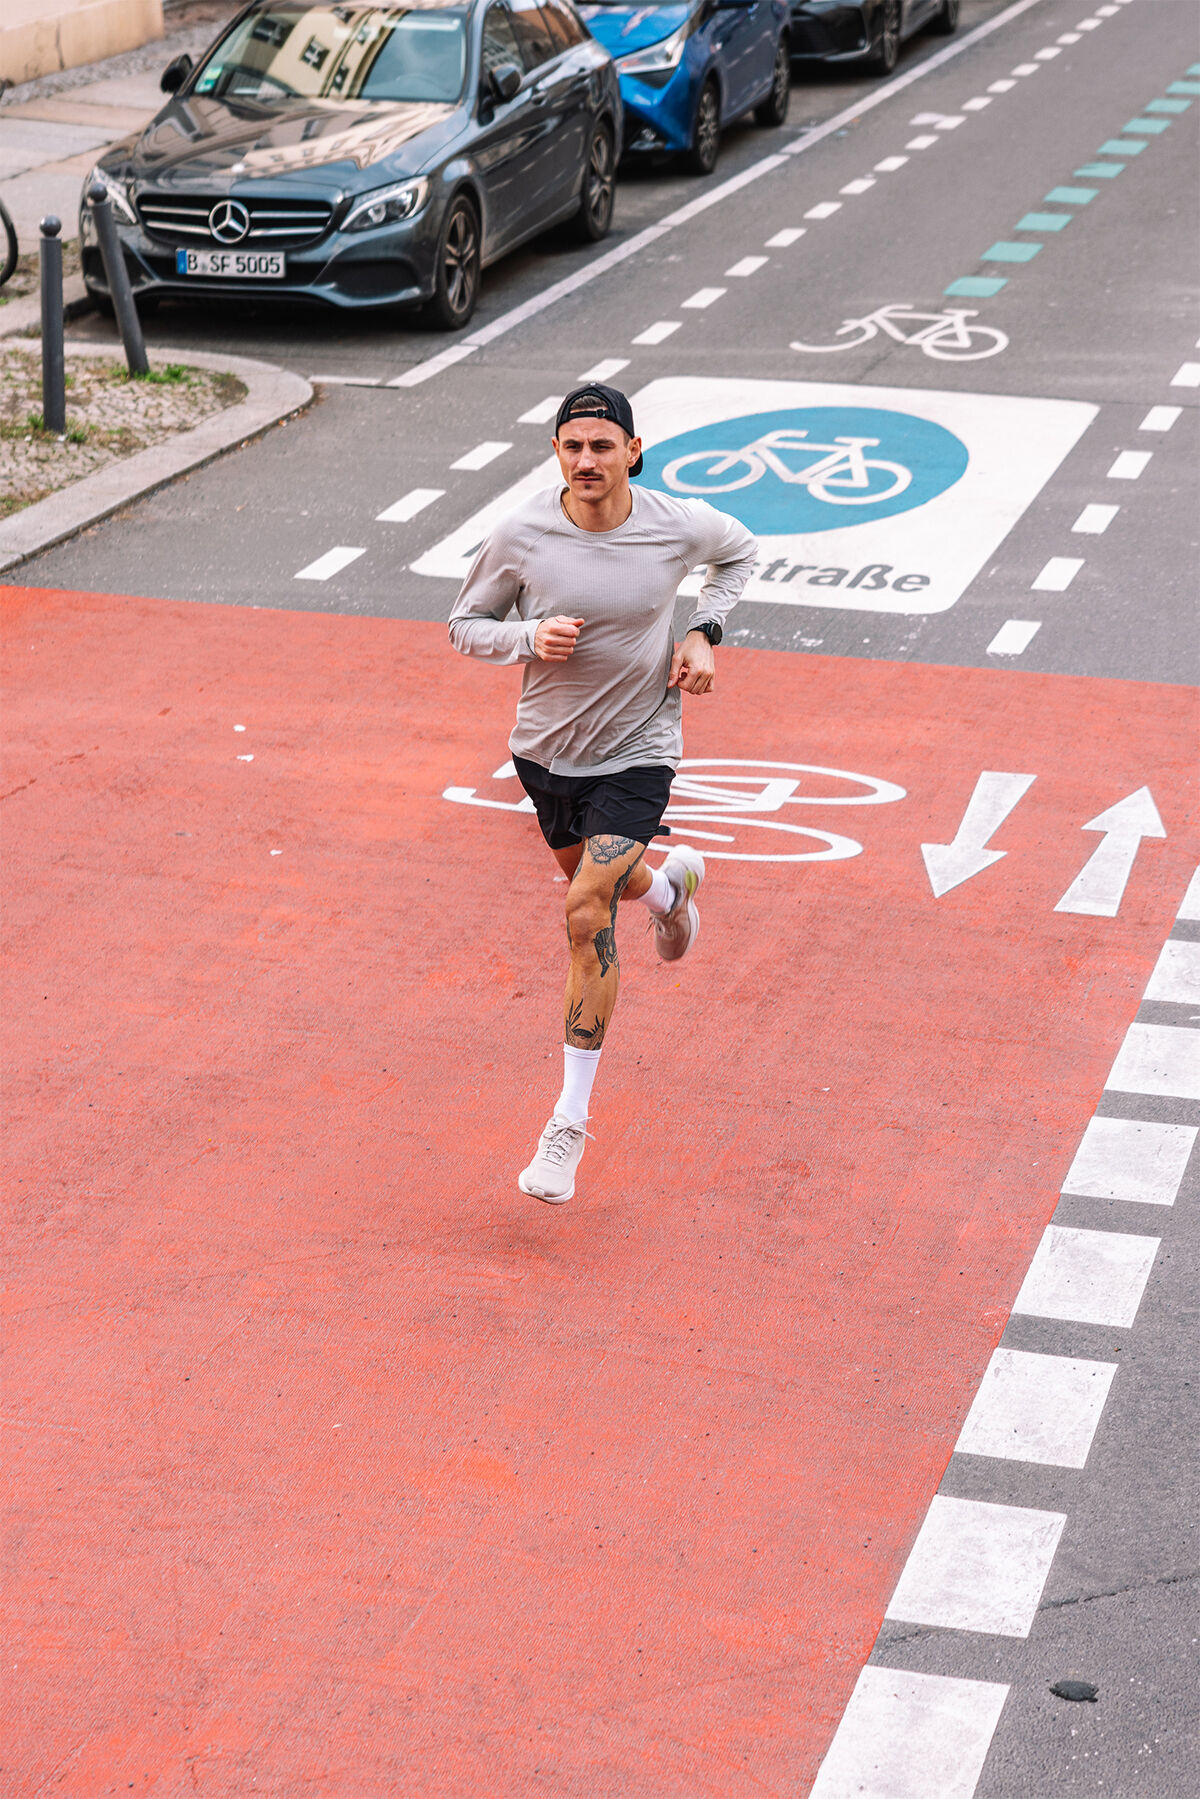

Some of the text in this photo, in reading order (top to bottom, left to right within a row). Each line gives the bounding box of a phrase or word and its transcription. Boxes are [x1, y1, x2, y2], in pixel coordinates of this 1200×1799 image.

[187, 254, 281, 274] B SF 5005
